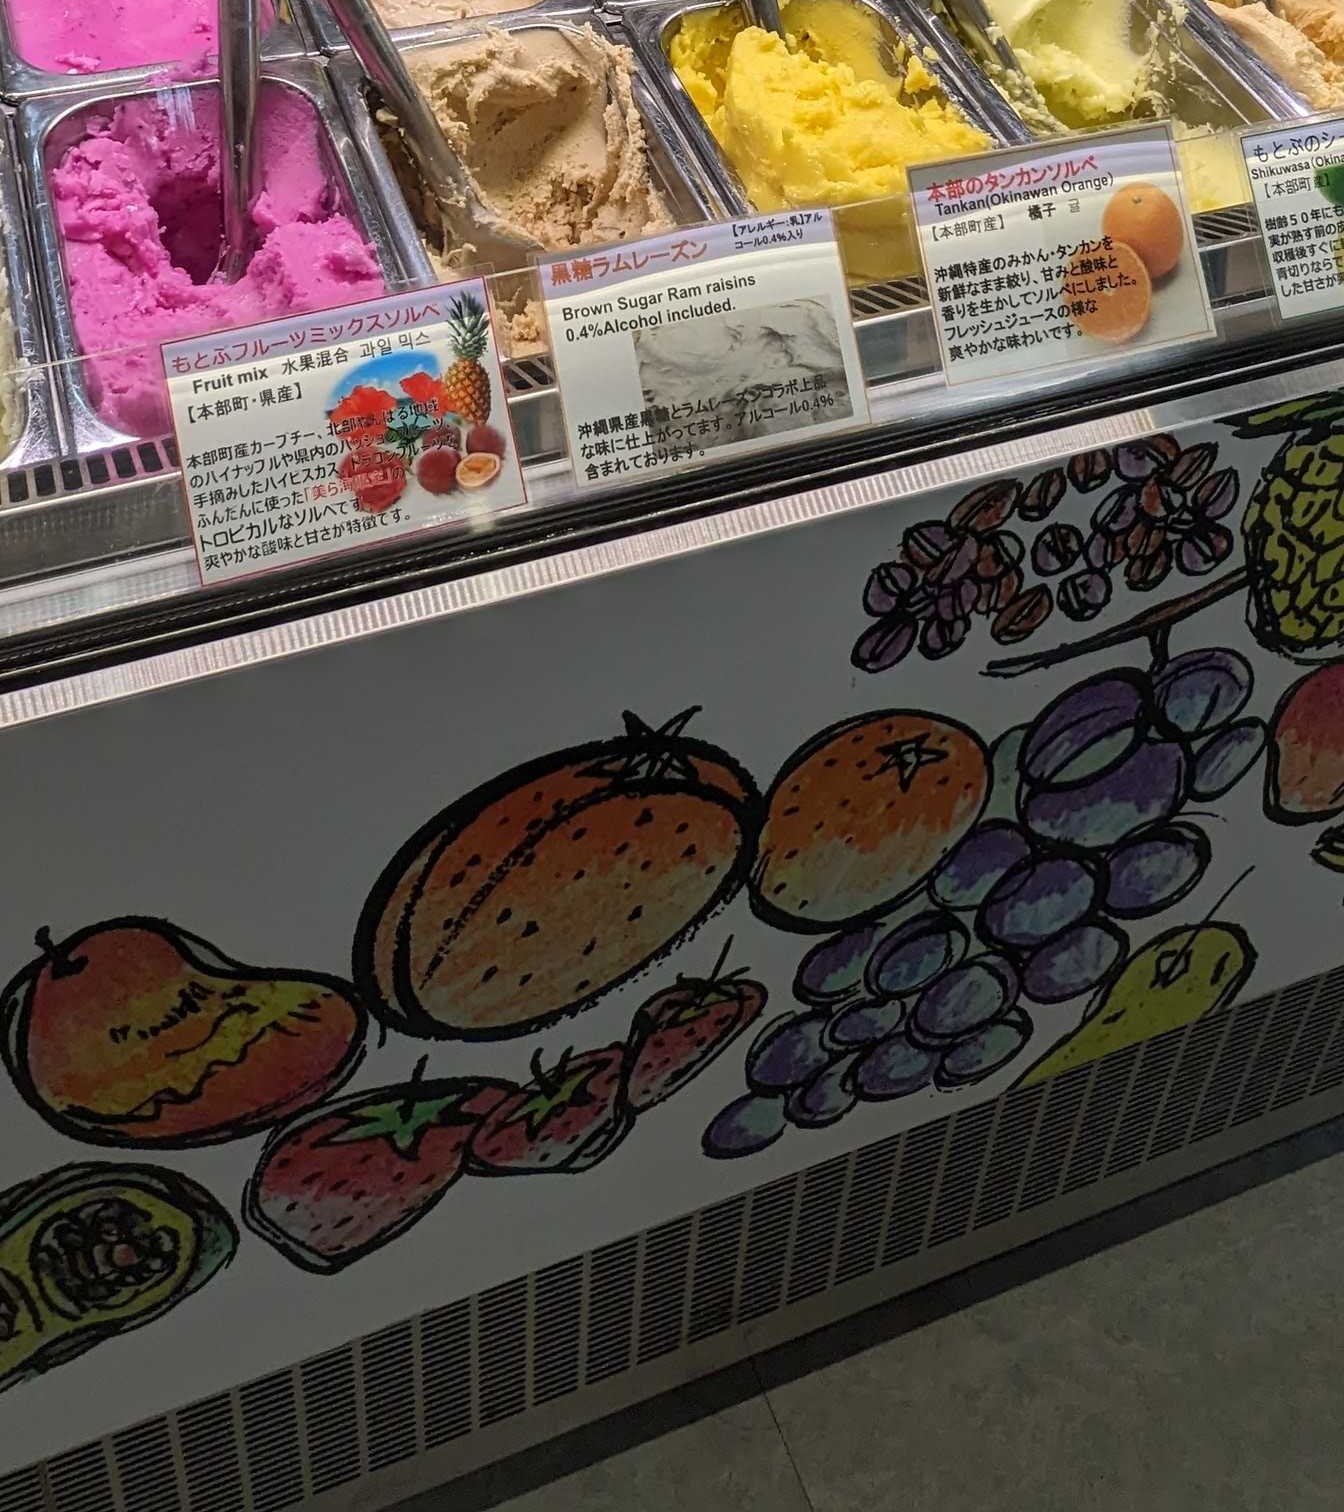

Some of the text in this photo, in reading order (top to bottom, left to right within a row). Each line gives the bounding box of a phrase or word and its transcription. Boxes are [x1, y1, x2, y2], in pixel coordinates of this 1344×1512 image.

[935, 171, 1115, 218] Tankan(Okinawan Orange)
[930, 214, 1007, 242] 【本部町産】
[550, 240, 709, 287] 黒糖ラムレーズン
[562, 273, 758, 322] Brown Sugar Ram raisins
[565, 297, 737, 344] 0.4%Alcohol included.
[192, 330, 432, 395] Fruit mix 水果混合 과일 믹스
[584, 441, 707, 482] 含まれております。
